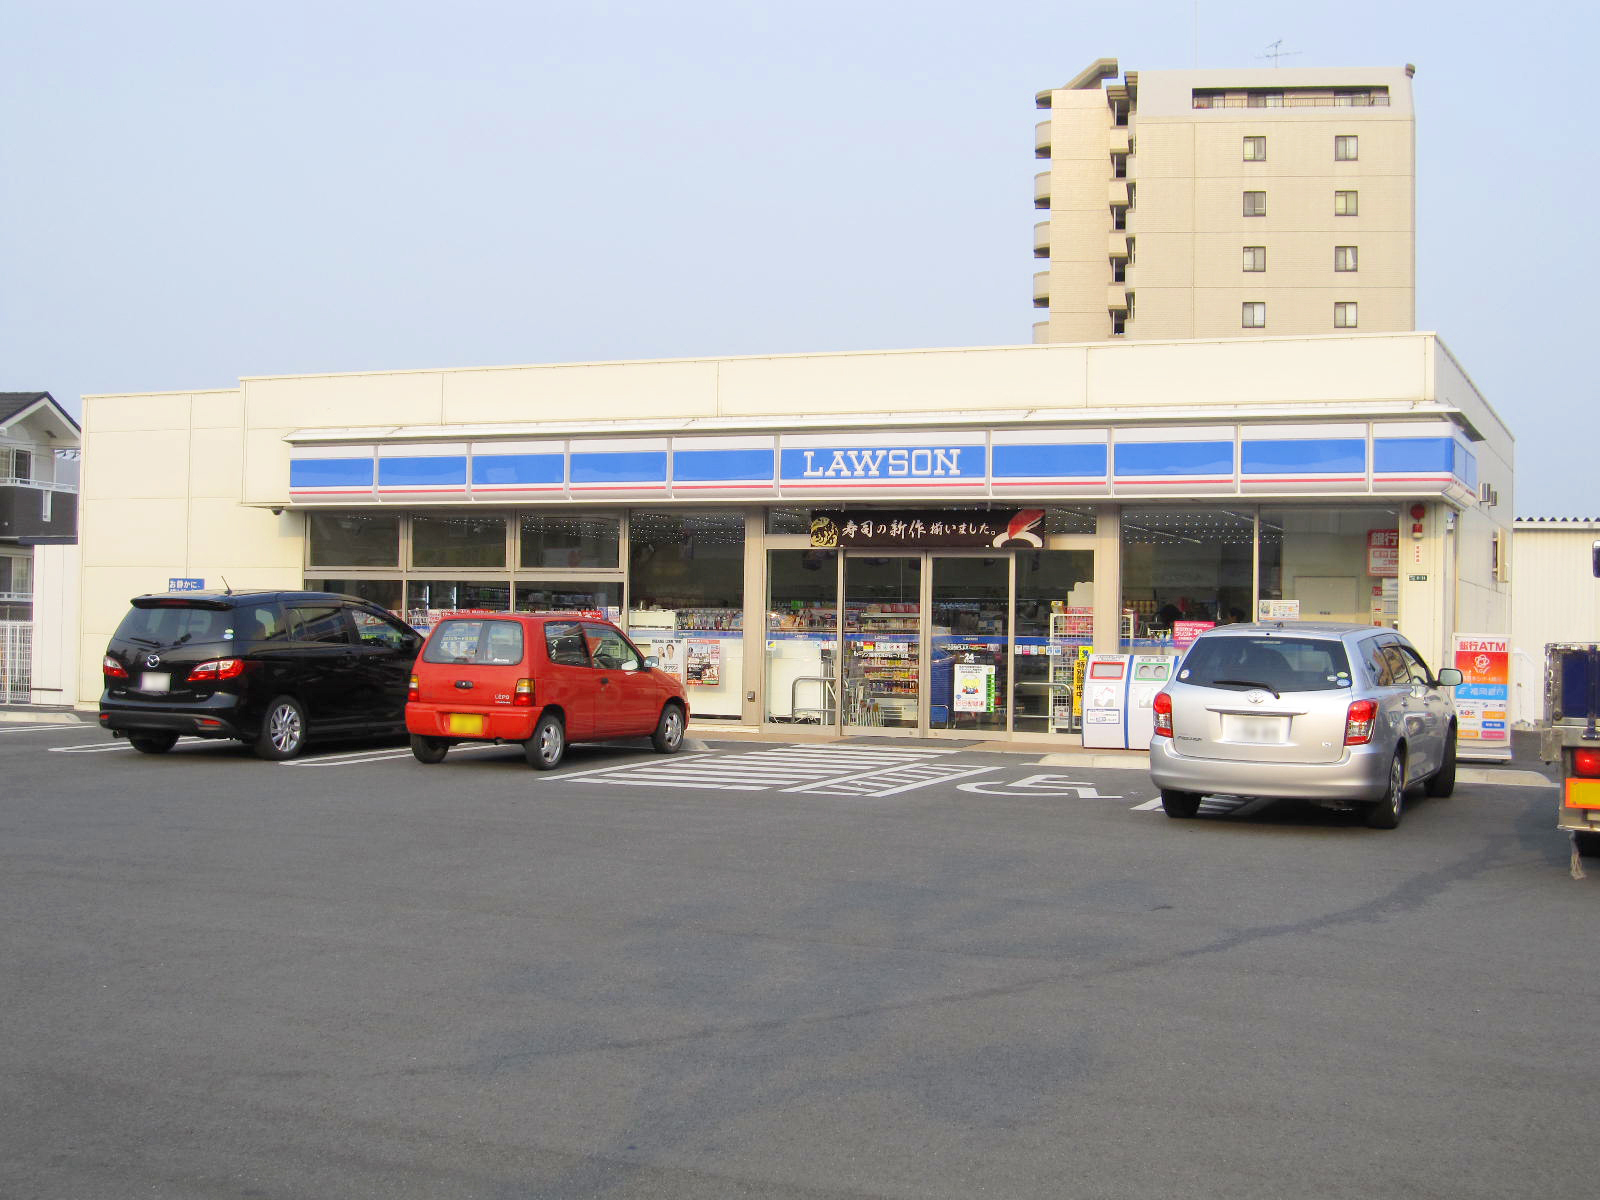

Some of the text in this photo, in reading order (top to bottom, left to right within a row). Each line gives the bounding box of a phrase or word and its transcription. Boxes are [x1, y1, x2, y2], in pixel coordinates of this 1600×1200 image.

[803, 448, 961, 477] LAWSON
[841, 519, 996, 540] 寿司の新作揃いました。
[1460, 641, 1506, 652] 銀行ATM
